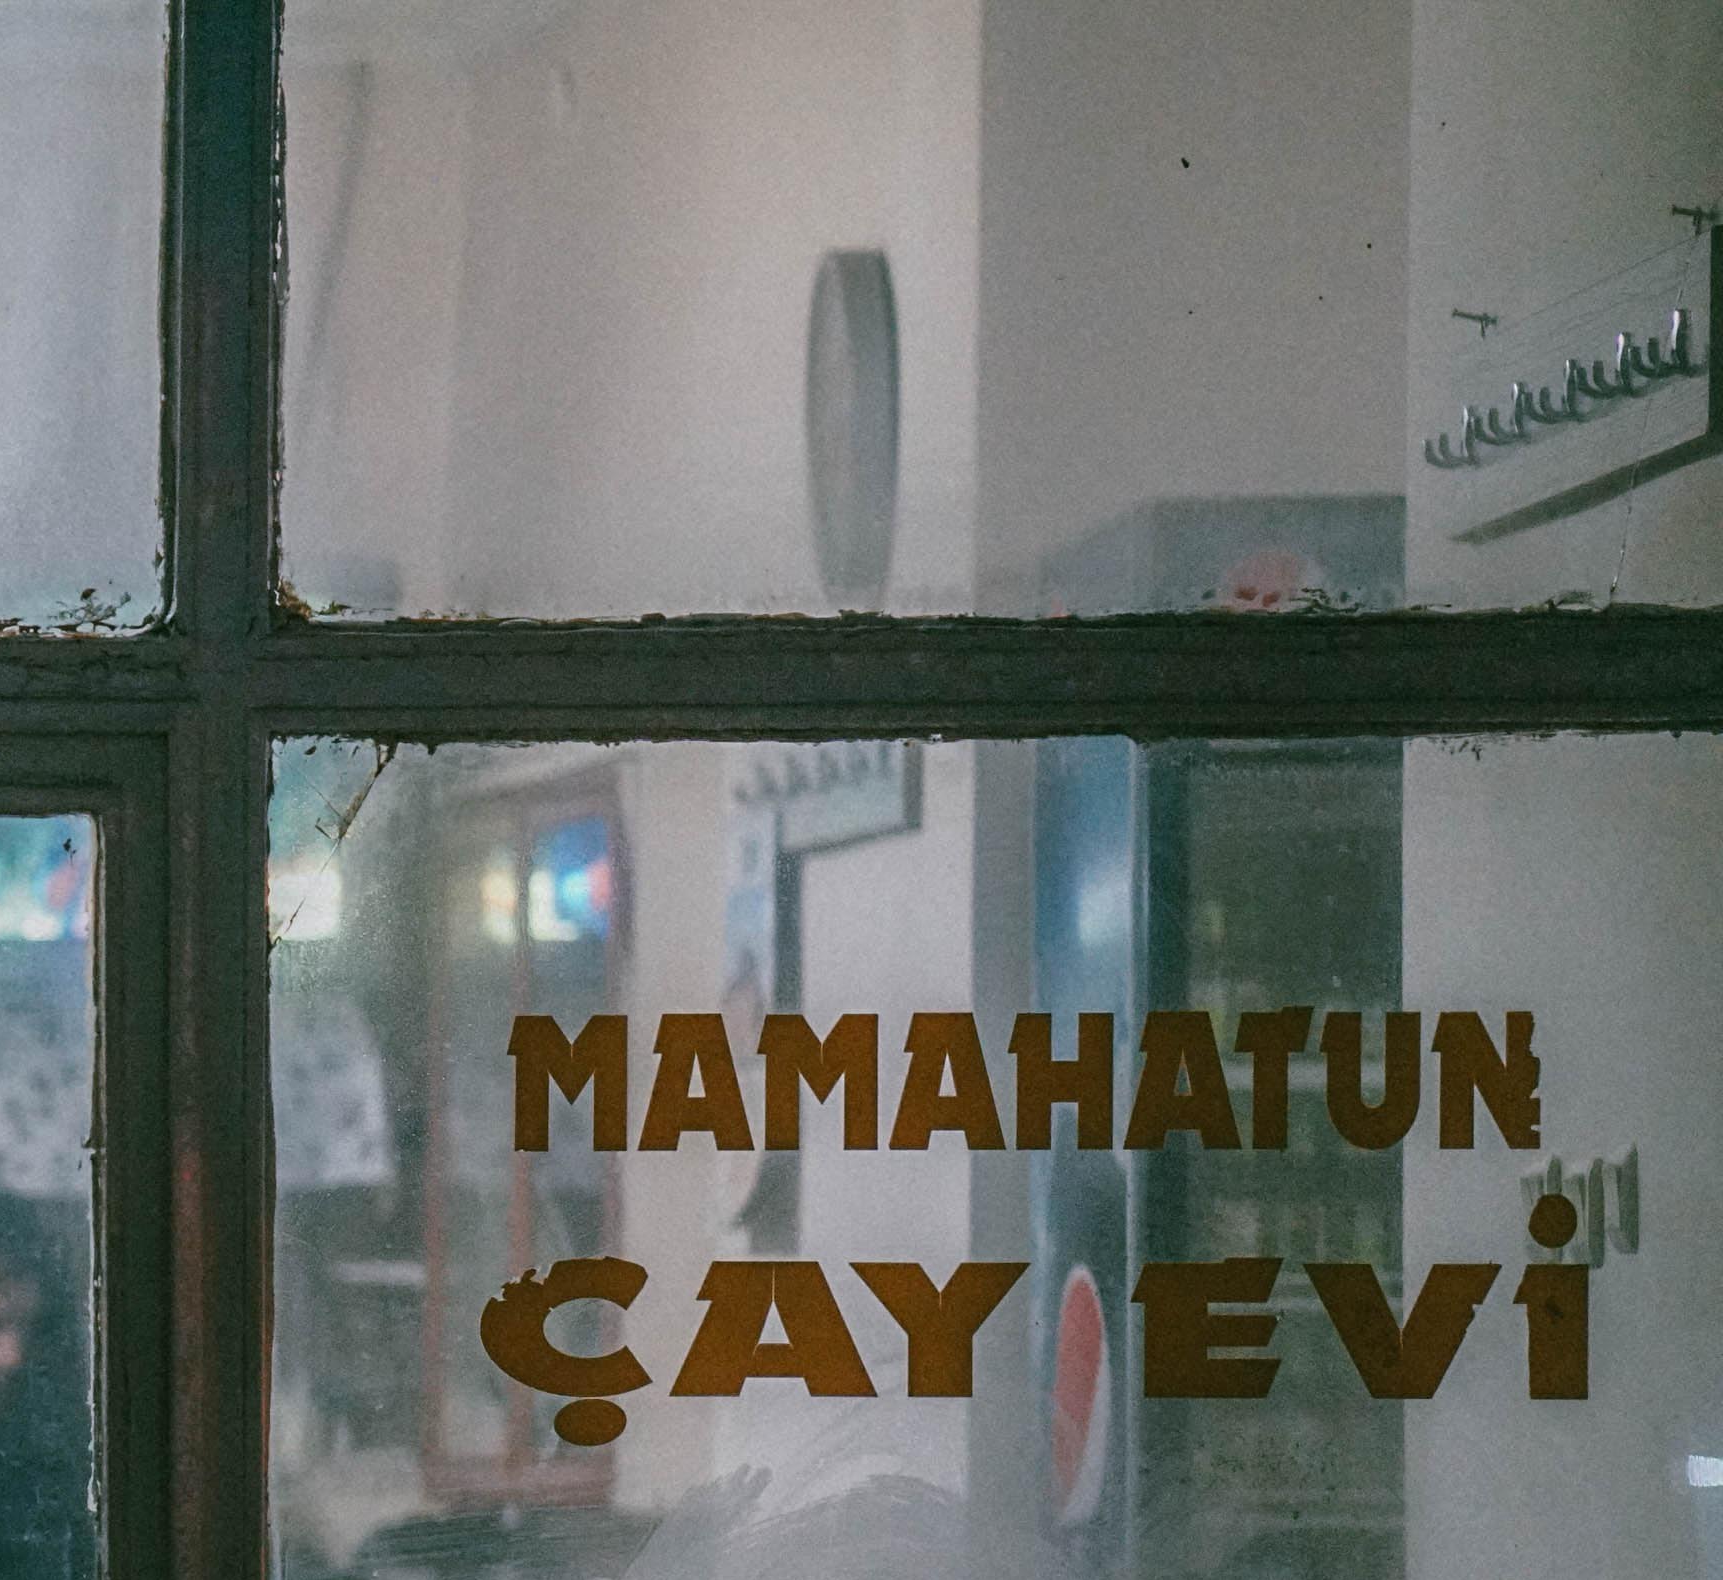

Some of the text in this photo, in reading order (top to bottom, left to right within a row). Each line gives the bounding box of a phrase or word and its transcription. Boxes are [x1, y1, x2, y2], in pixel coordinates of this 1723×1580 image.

[506, 1004, 1542, 1152] MAMAHATUN
[478, 1192, 1591, 1447] ÇAY EVİ
